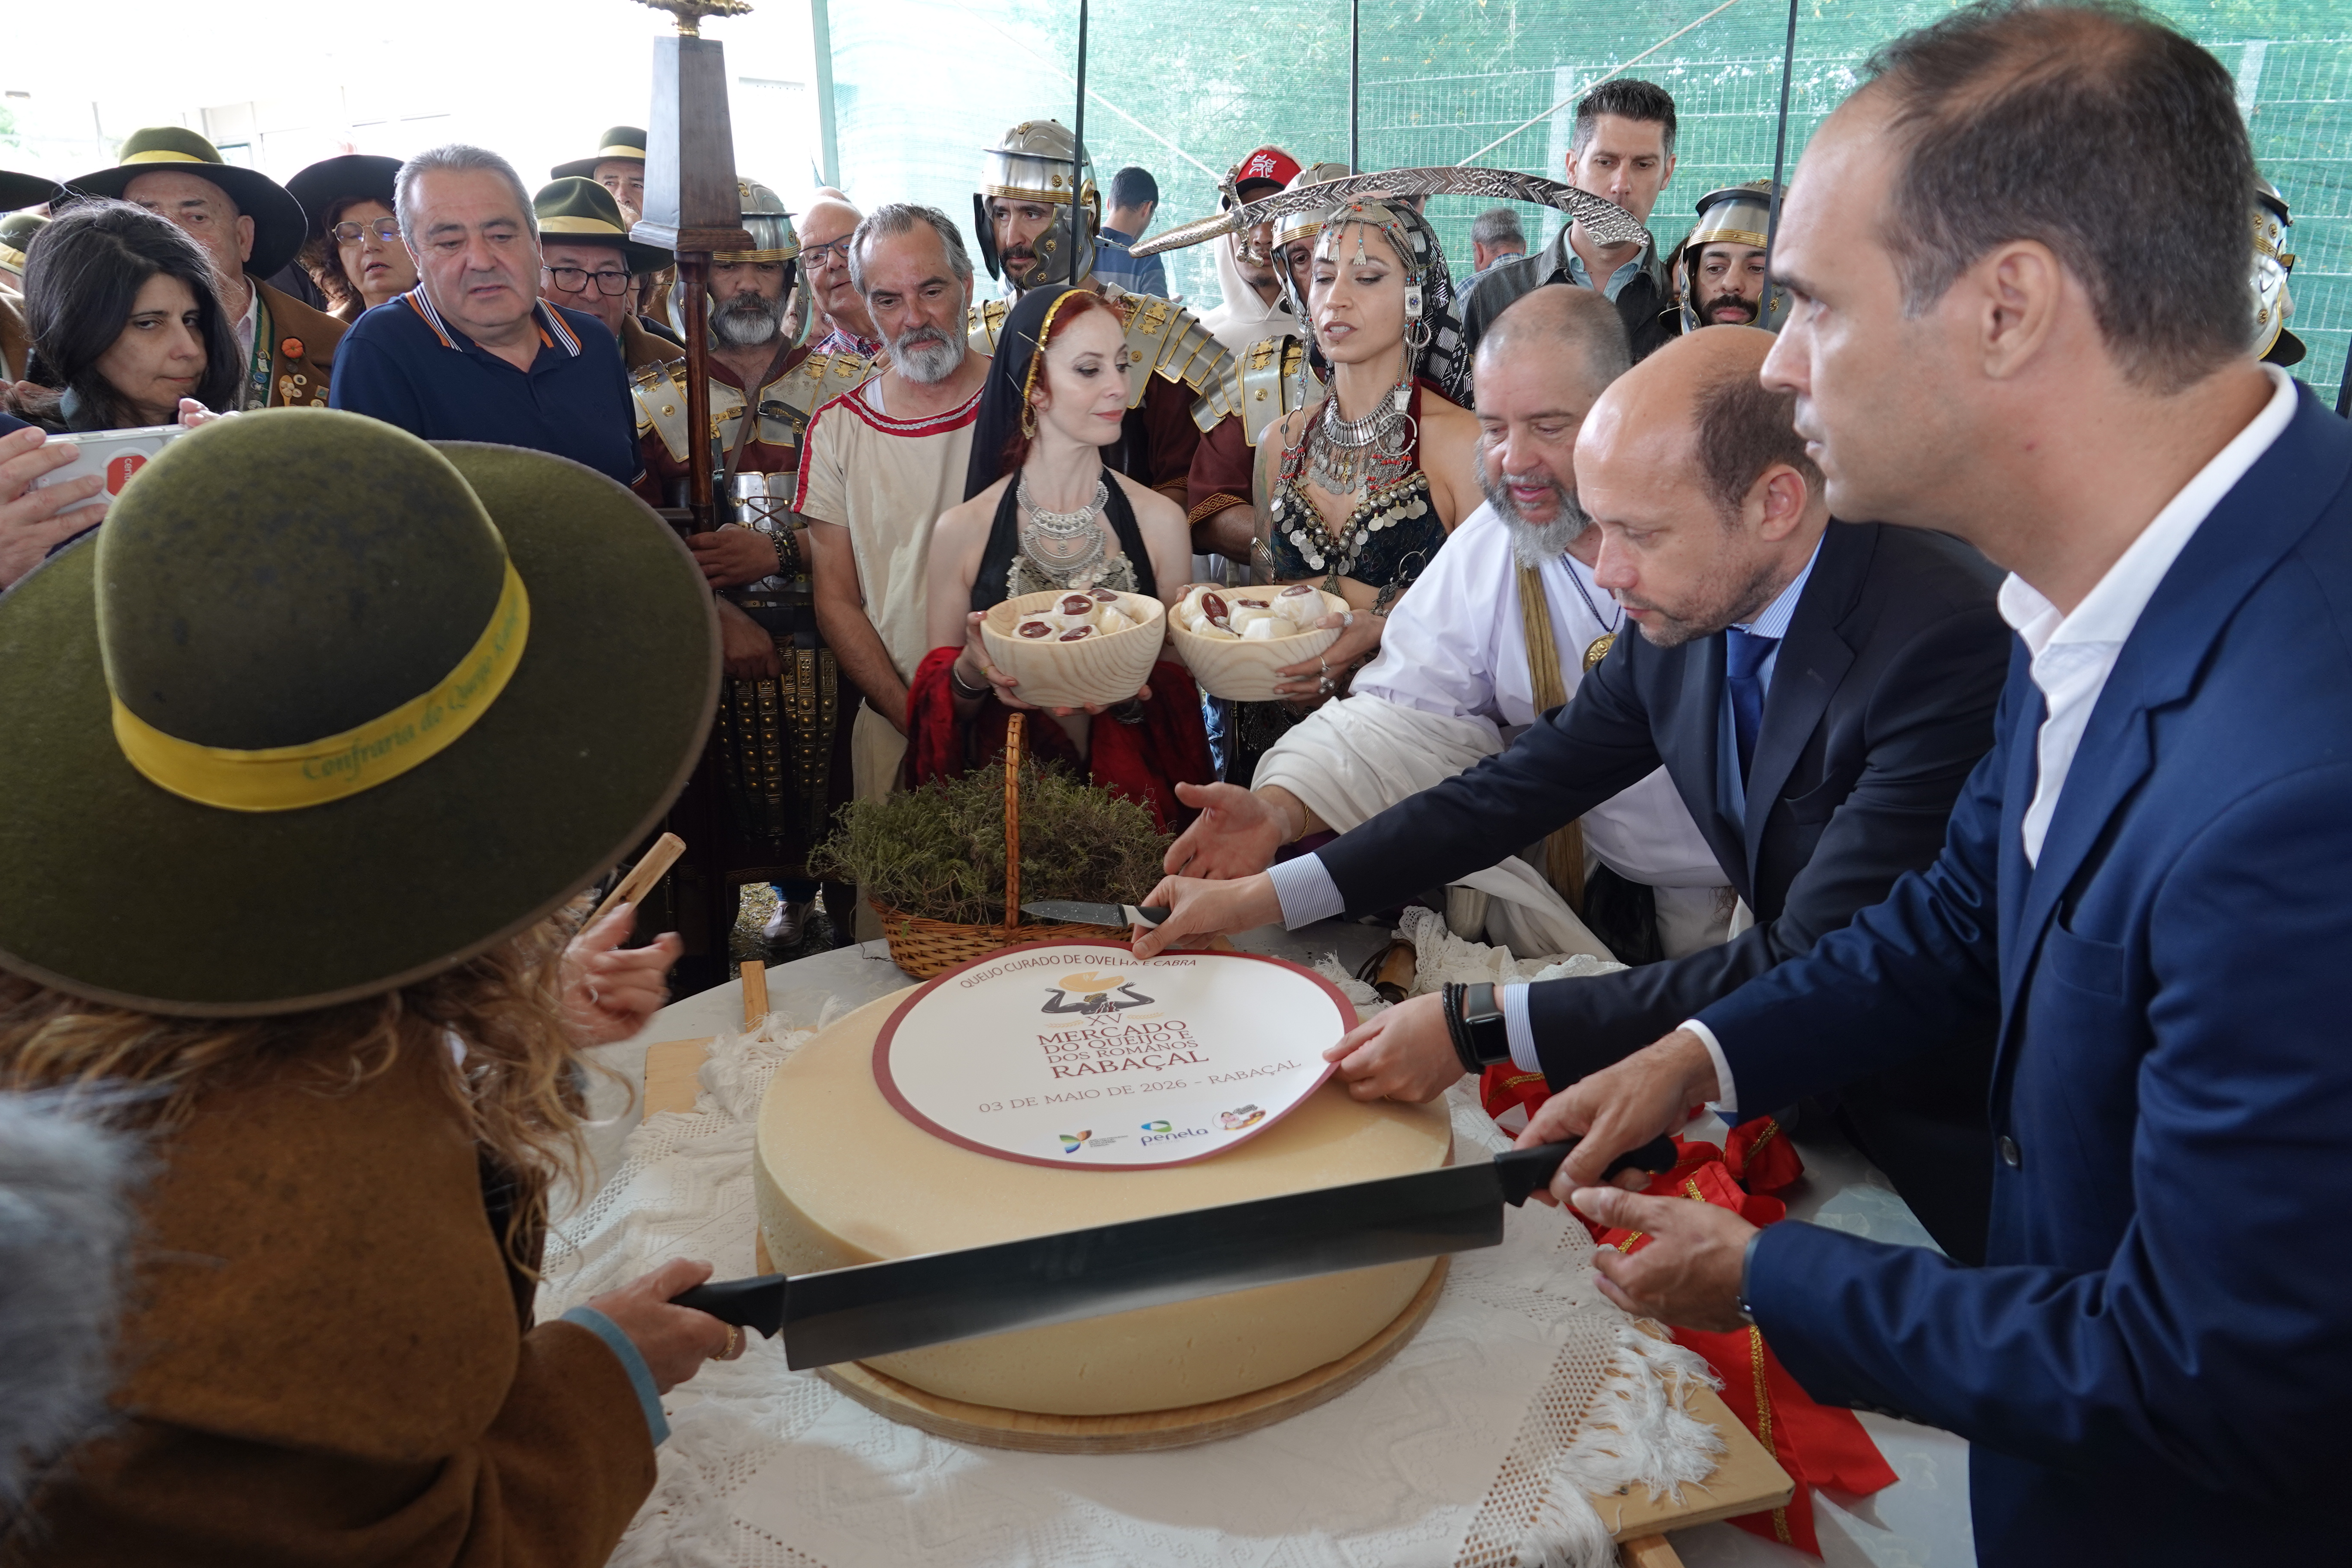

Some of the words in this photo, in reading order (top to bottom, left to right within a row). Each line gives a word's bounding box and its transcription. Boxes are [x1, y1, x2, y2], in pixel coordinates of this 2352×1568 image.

[303, 723, 416, 782] Confraria
[960, 967, 1003, 988] QUEIJO
[1004, 955, 1060, 972] CURADO
[1063, 954, 1082, 964] DE
[1084, 955, 1139, 966] OVELHA
[1084, 1013, 1123, 1026] XV
[1036, 1020, 1187, 1045] MERCADO
[1042, 1042, 1080, 1054] DO
[1088, 1032, 1171, 1049] QUEIJO
[1177, 1030, 1193, 1039] E
[1047, 1051, 1090, 1063] DOS
[1095, 1040, 1198, 1058] ROMANOS
[1050, 1050, 1210, 1078] RABAÇAL
[979, 1101, 1004, 1112] 03
[1009, 1097, 1038, 1109] DE
[1044, 1089, 1100, 1104] MAIO
[1106, 1085, 1135, 1096] DE
[1140, 1079, 1187, 1092] 2026
[1207, 1060, 1302, 1084] RABAÇAL
[1141, 1128, 1209, 1146] penela
